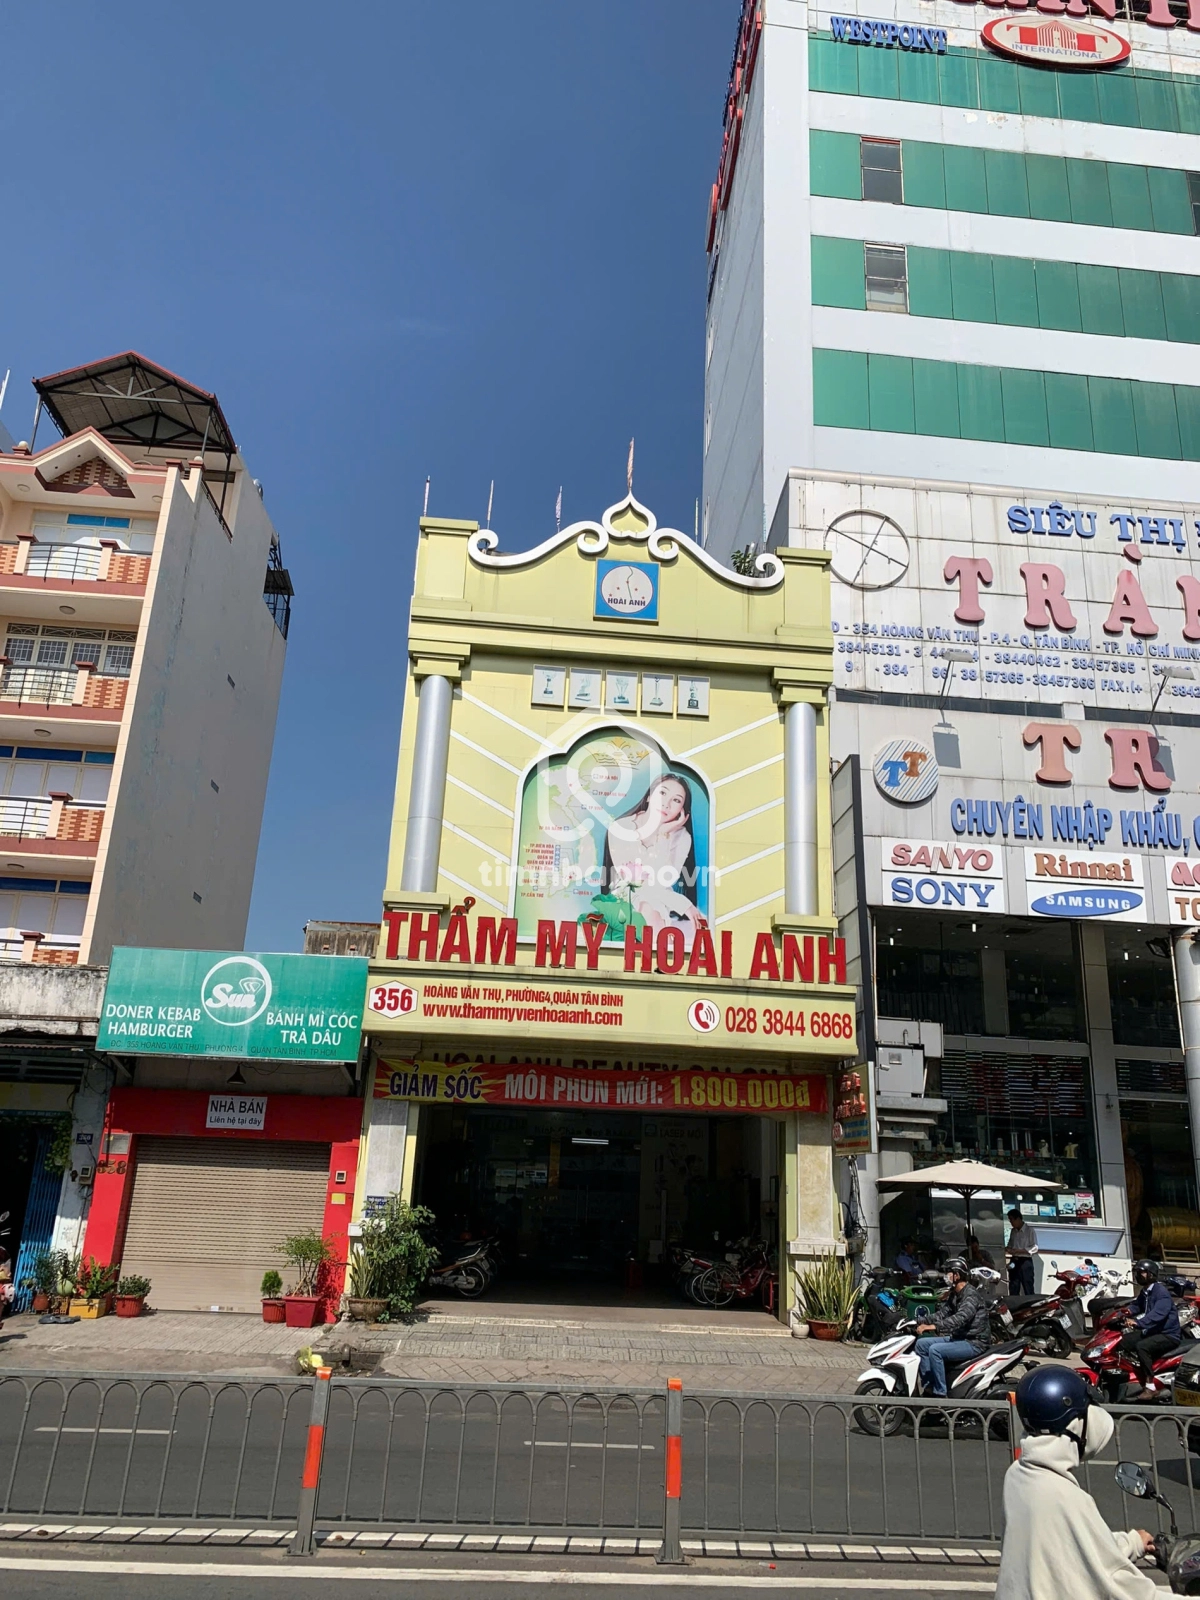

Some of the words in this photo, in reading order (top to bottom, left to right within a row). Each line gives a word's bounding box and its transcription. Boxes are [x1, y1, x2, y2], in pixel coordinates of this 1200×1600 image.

[831, 16, 948, 52] WESTPOINT
[1012, 43, 1104, 59] INTERNATIONAL
[1007, 500, 1097, 539] SIÊU
[1109, 513, 1186, 553] THỊ
[853, 623, 878, 636] 354
[838, 641, 901, 657] 38445131
[994, 652, 1060, 667] 38440462
[1072, 657, 1136, 674] 38457395
[950, 795, 1044, 840] CHUYÊN
[1051, 801, 1113, 850] NHẬP
[891, 844, 993, 873] SANYO
[1034, 853, 1134, 882] Rinnai
[891, 877, 995, 908] SONY
[1045, 894, 1131, 910] SAMSUNG
[383, 896, 518, 966] THẨM
[535, 914, 608, 970] MỸ
[624, 918, 732, 978] HOÀI
[750, 932, 847, 985] ANH
[205, 983, 256, 1008] Sun
[373, 987, 413, 1012] 356
[424, 985, 458, 999] HOÀNG
[460, 985, 479, 1000] VĂN
[581, 992, 599, 1006] TÂN
[601, 992, 624, 1007] BÌNH
[106, 1004, 154, 1020] DONER
[158, 1006, 201, 1022] KEBAB
[267, 1010, 304, 1027] BÁNH
[308, 1011, 325, 1028] MÌ
[328, 1012, 359, 1030] CÓC
[423, 1003, 622, 1026] www.thammyvienhoaianh.com
[725, 1006, 757, 1034] 028
[763, 1009, 805, 1037] 3844
[810, 1012, 853, 1039] 6868
[108, 1022, 193, 1039] HAMBURGER
[281, 1028, 310, 1045] TRÀ
[312, 1029, 342, 1046] DÂU
[390, 1064, 438, 1097] GIẢM
[444, 1066, 483, 1099] SỐC
[505, 1069, 546, 1100] MÔI
[554, 1075, 608, 1104] PHUN
[616, 1076, 662, 1105] MỚI:
[671, 1076, 810, 1107] 1.800.000đ
[210, 1098, 235, 1114] NHÀ
[239, 1098, 264, 1115] BÁN
[209, 1115, 225, 1125] Liên
[227, 1116, 236, 1127] hệ
[237, 1116, 247, 1127] tại
[248, 1117, 262, 1128] đây
